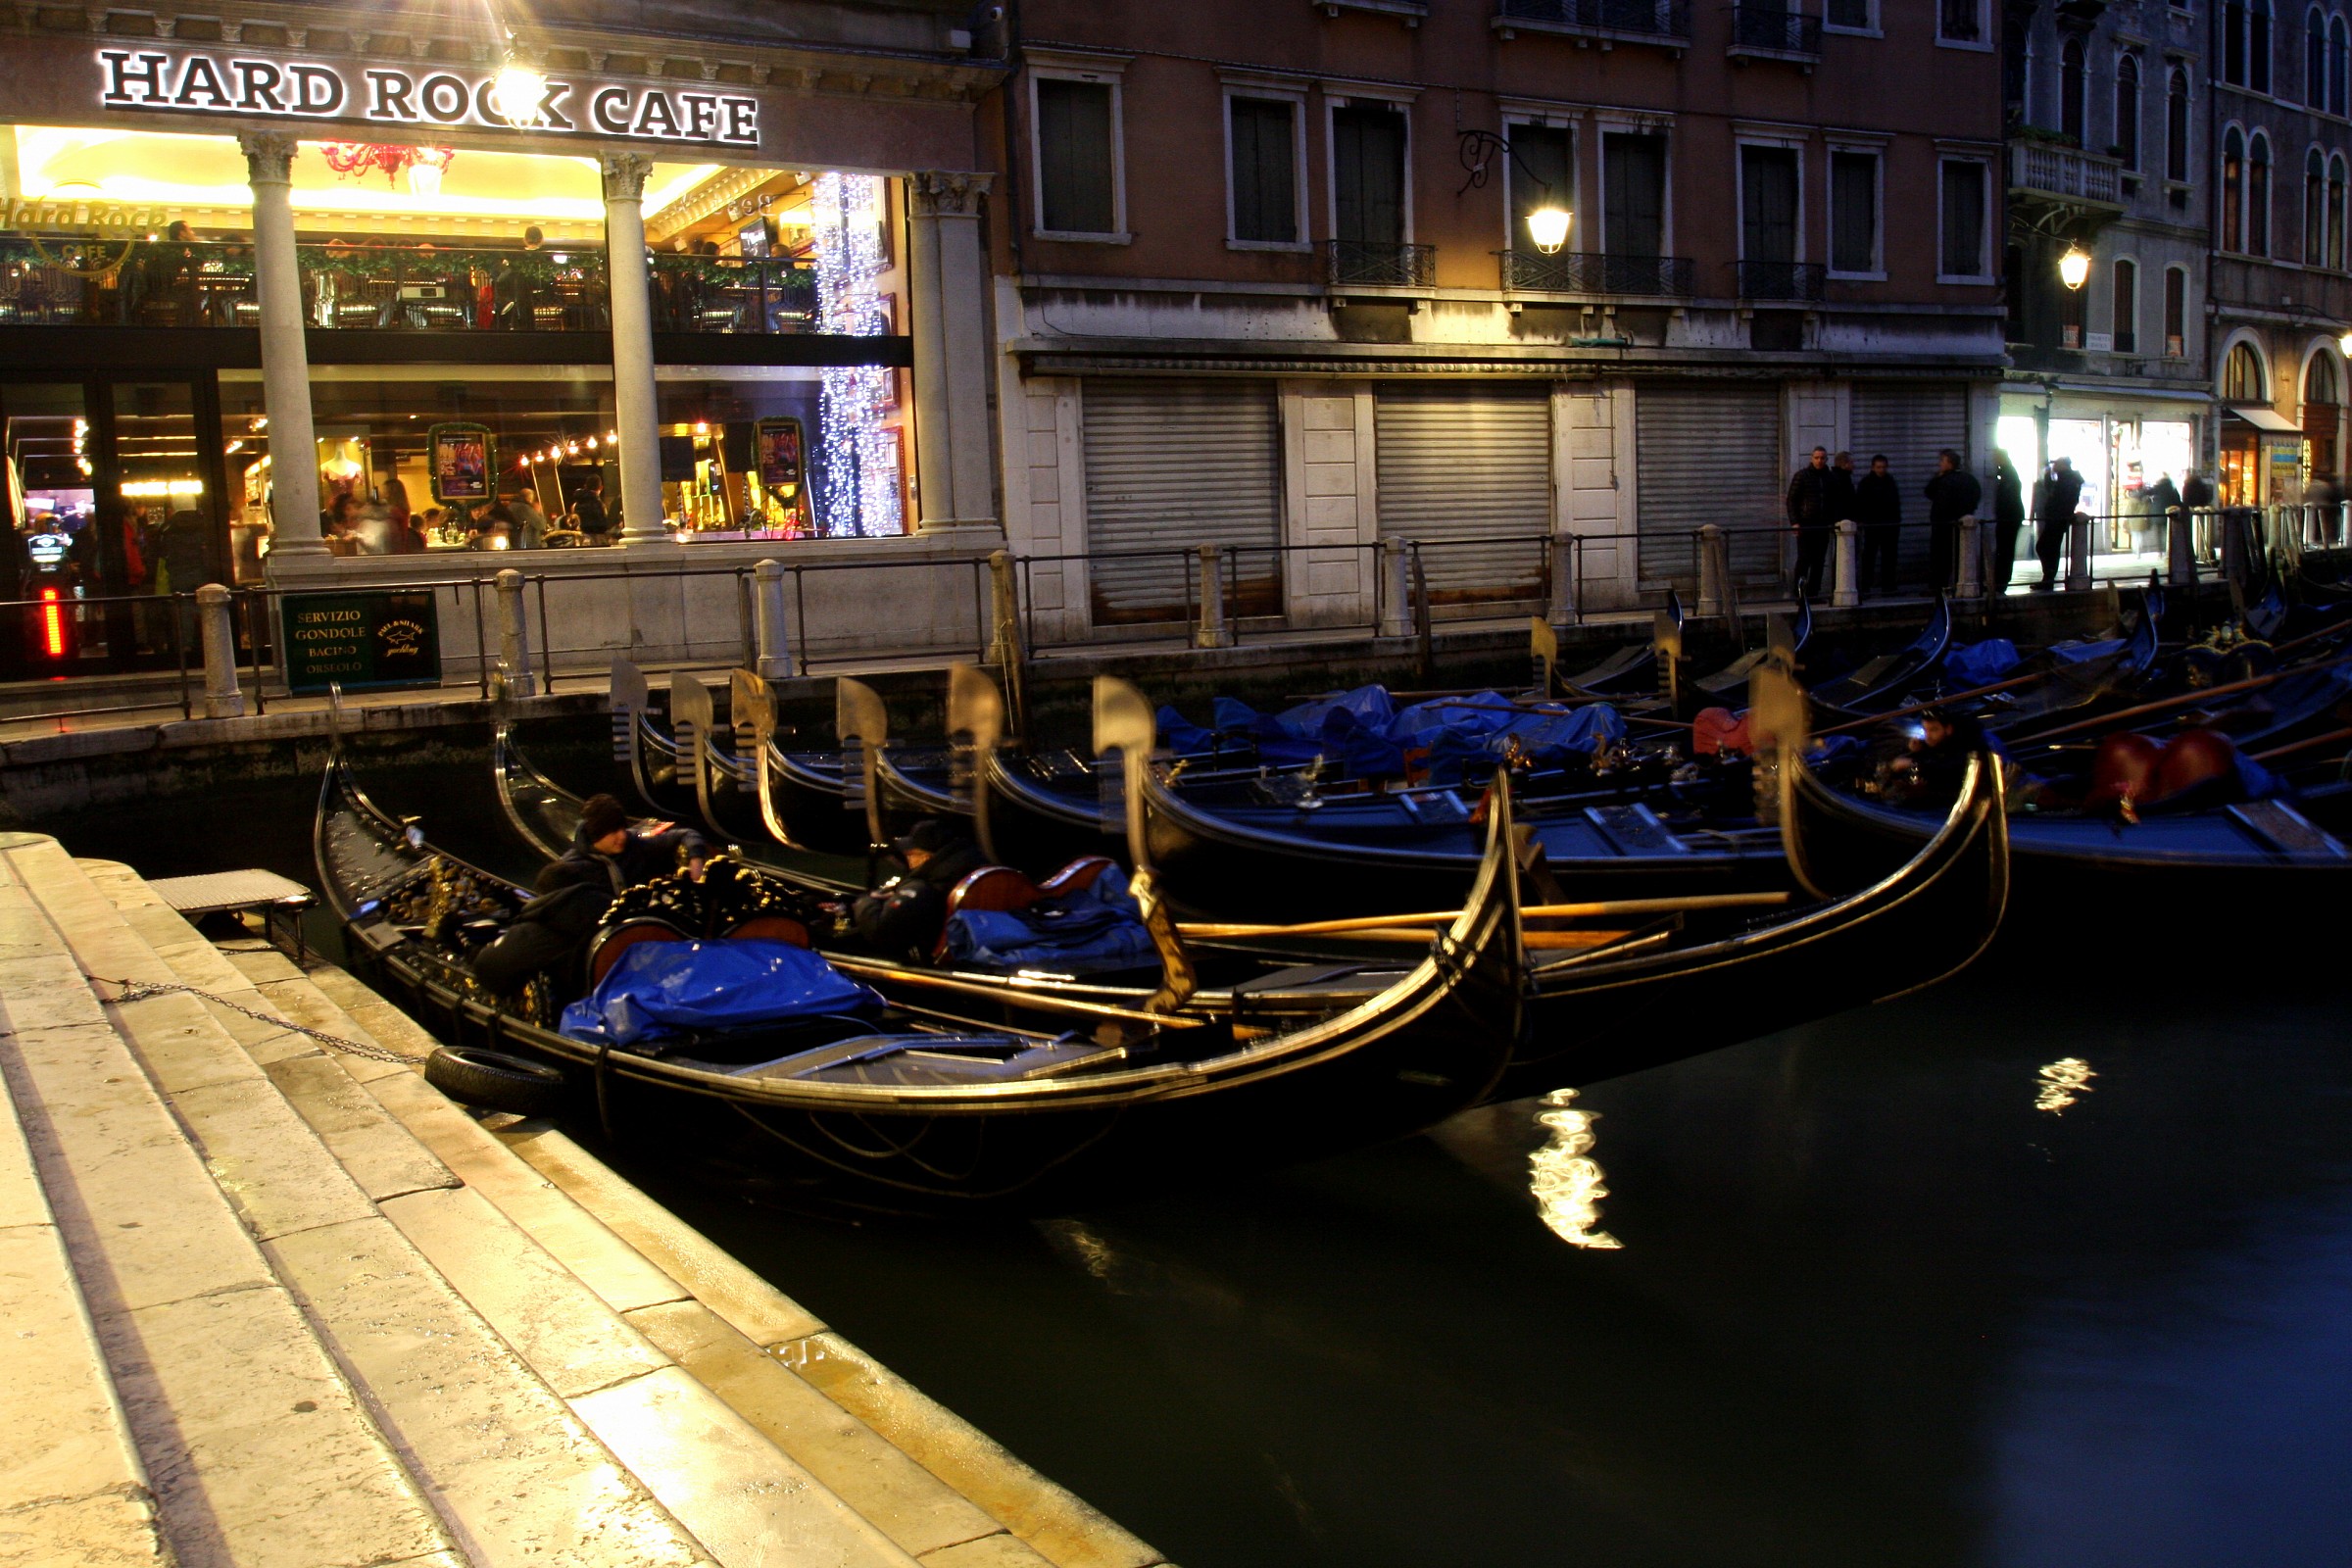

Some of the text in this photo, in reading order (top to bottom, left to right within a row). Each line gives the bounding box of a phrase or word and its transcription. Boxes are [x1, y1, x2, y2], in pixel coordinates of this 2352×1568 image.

[101, 51, 759, 143] HARD ROCK CAFE
[85, 200, 169, 240] Rock
[62, 245, 107, 259] CAFE
[297, 610, 361, 623] SERVIZIO
[295, 626, 367, 641] GONDOLE
[308, 645, 357, 658] BACINO
[306, 662, 363, 674] ORSEOLO
